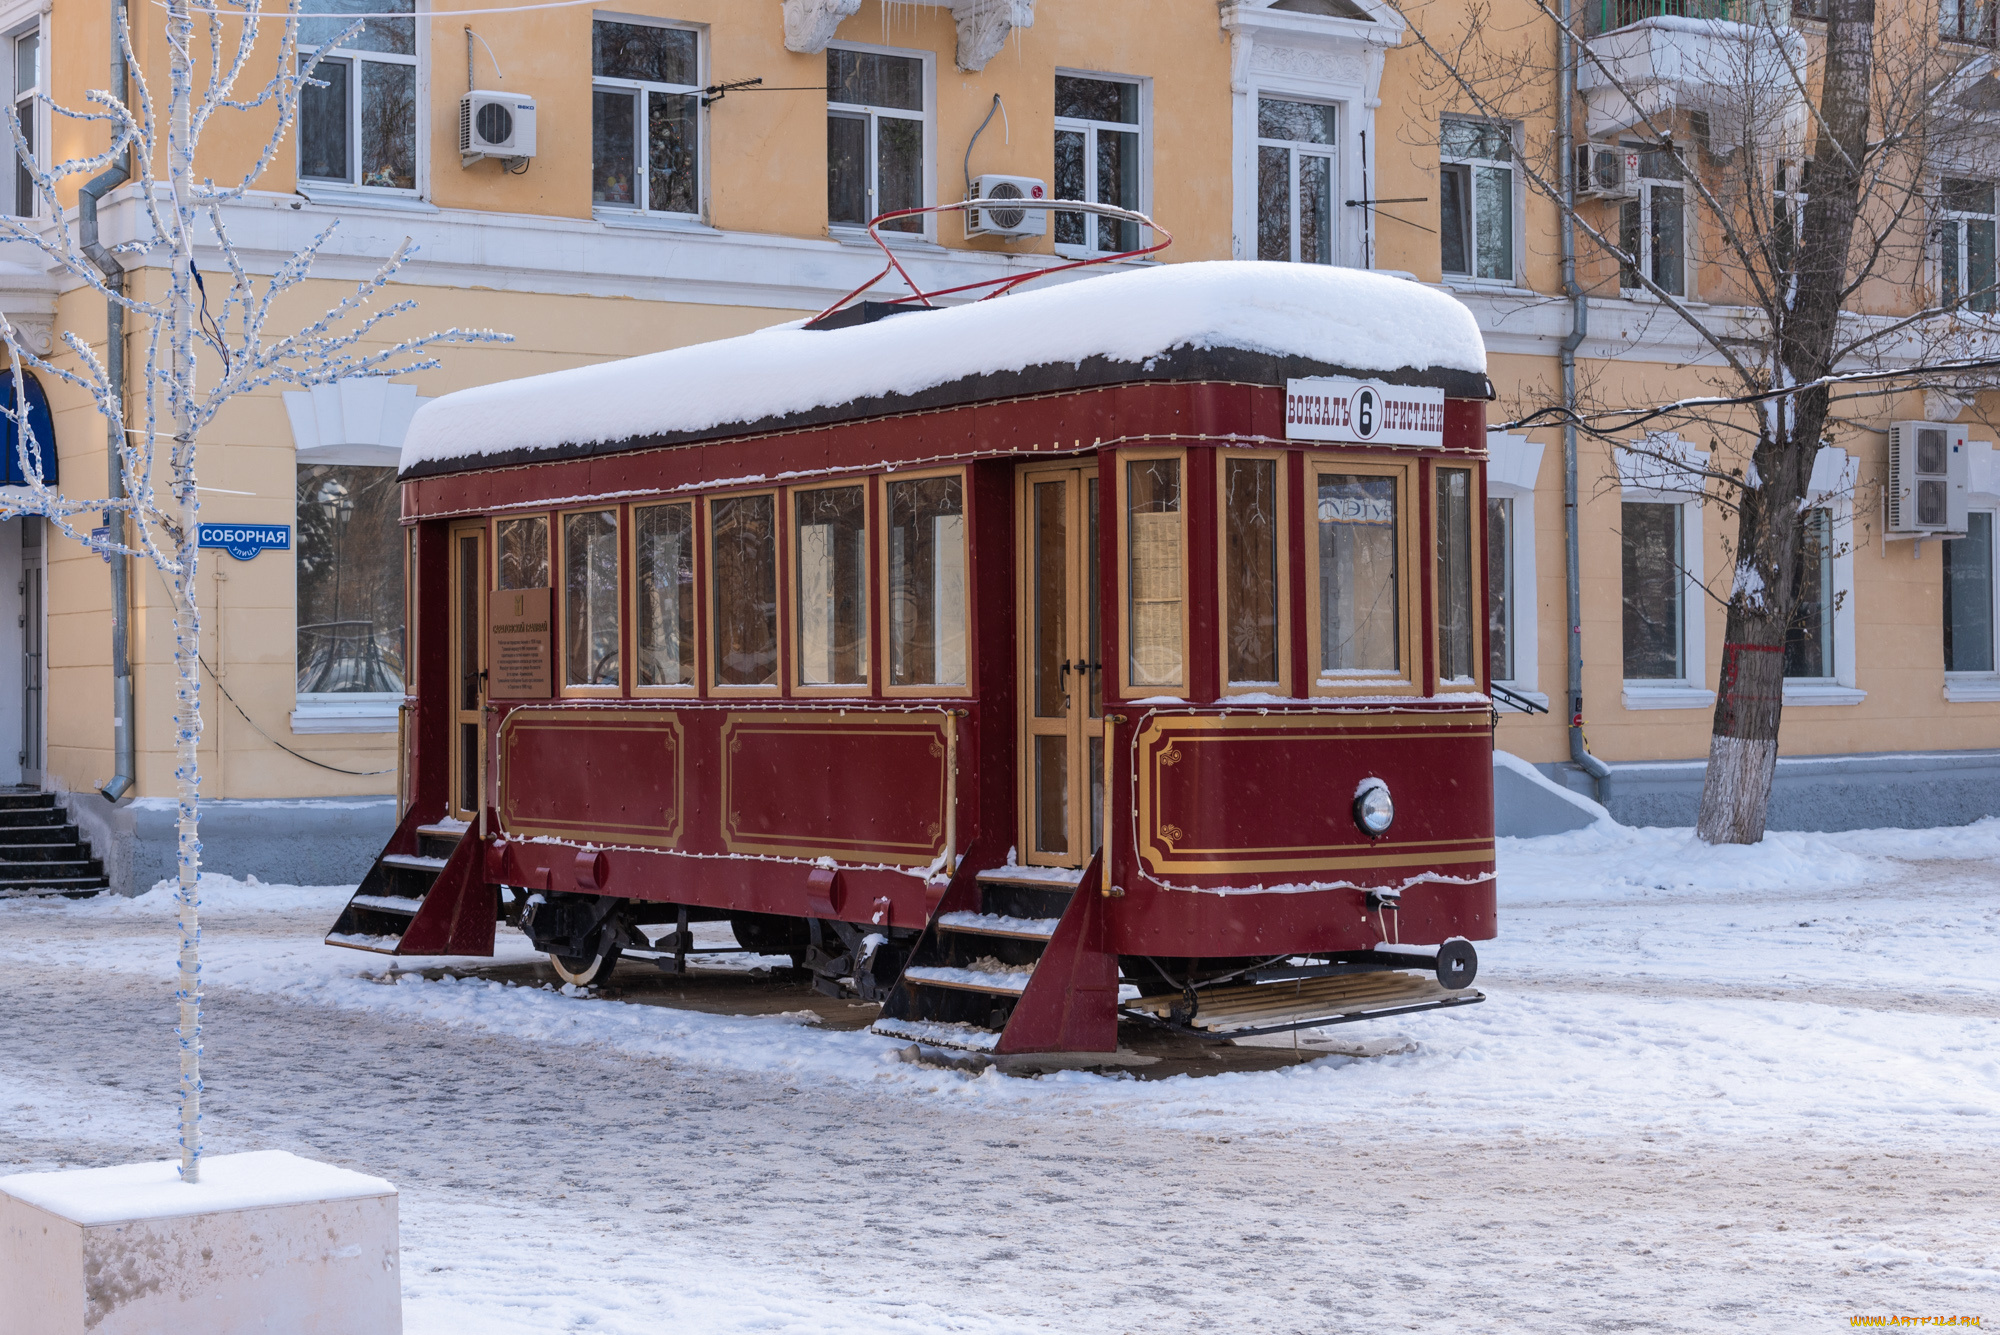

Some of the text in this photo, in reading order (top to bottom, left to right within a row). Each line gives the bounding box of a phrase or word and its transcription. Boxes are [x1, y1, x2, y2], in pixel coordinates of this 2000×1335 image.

[1288, 390, 1443, 436] ВОКЗАЛЪ 6 ПРИСТАНИ
[202, 529, 286, 543] СОБОРНАЯ
[232, 546, 257, 557] УЛИЦА
